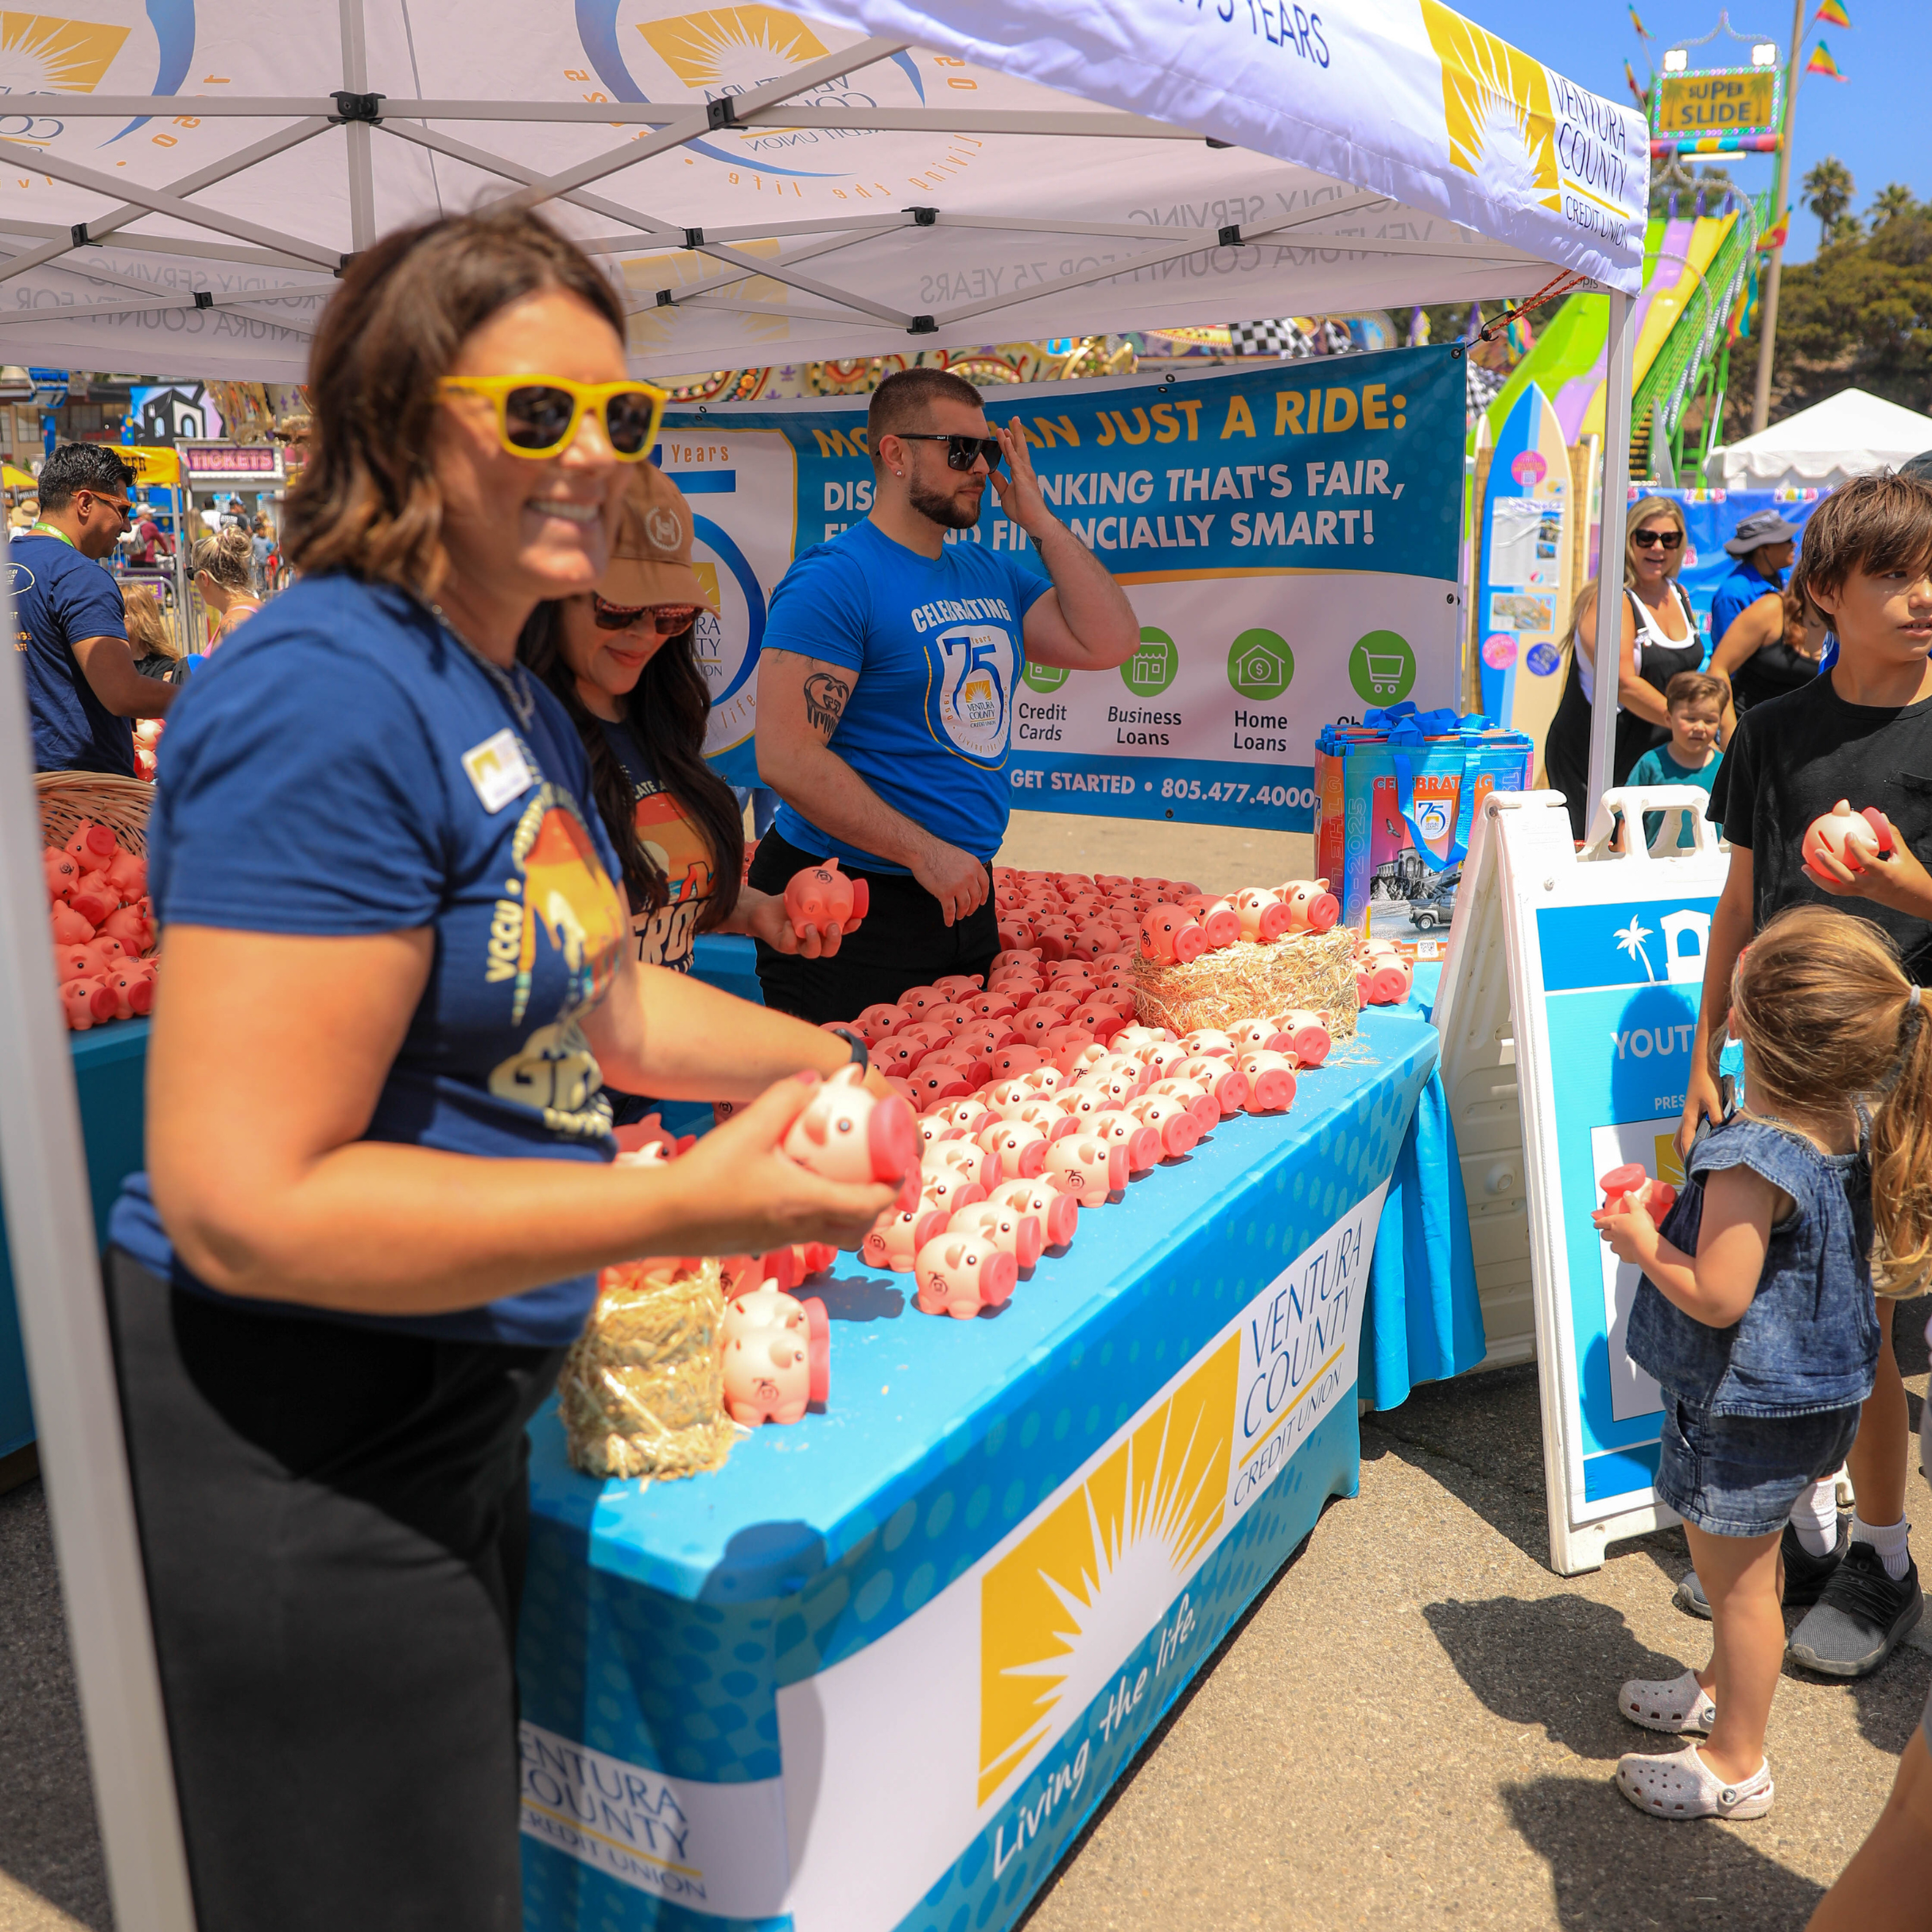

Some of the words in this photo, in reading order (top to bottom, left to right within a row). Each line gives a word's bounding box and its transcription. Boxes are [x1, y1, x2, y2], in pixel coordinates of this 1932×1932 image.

[1548, 70, 1626, 156] VENTURA
[1681, 102, 1752, 125] SLIDE
[1558, 122, 1627, 202] COUNTY
[1565, 196, 1600, 233] CREDIT
[1600, 214, 1628, 250] UNION
[1096, 399, 1204, 446] JUST
[1220, 394, 1257, 440] A
[1274, 383, 1407, 436] RIDE:
[188, 448, 274, 471] TICKETS
[671, 444, 729, 464] Years
[1166, 463, 1294, 502] THAT'S
[1306, 458, 1406, 500] FAIR,
[1230, 509, 1375, 548] SMART!
[911, 598, 1012, 633] CELEBRATING
[971, 634, 991, 645] Years
[942, 636, 1004, 740] 75
[966, 700, 995, 711] VENTURA
[968, 709, 995, 720] COUNTY
[1018, 702, 1067, 722] Credit
[1108, 706, 1182, 727] Business
[1234, 711, 1288, 730] Home
[1018, 723, 1062, 742] Cards
[1116, 727, 1170, 747] Loans
[1233, 732, 1287, 752] Loans
[1011, 769, 1046, 790] GET
[1050, 770, 1136, 795] STARTED
[1162, 778, 1316, 810] 805.477.4000
[1347, 797, 1367, 875] 2025
[1418, 802, 1446, 835] 75
[485, 898, 523, 983] VCCU
[1610, 1023, 1697, 1060] YOUT
[1249, 1216, 1363, 1368] VENTURA
[1242, 1278, 1356, 1439] COUNTY
[1232, 1416, 1295, 1507] CREDIT
[1295, 1362, 1343, 1431] UNION
[992, 1734, 1091, 1882] Living
[1100, 1666, 1148, 1744] the
[1154, 1592, 1197, 1678] life.
[519, 1728, 689, 1824] ENTURA
[522, 1767, 689, 1860] OUNTY
[609, 1849, 708, 1900] UNION
